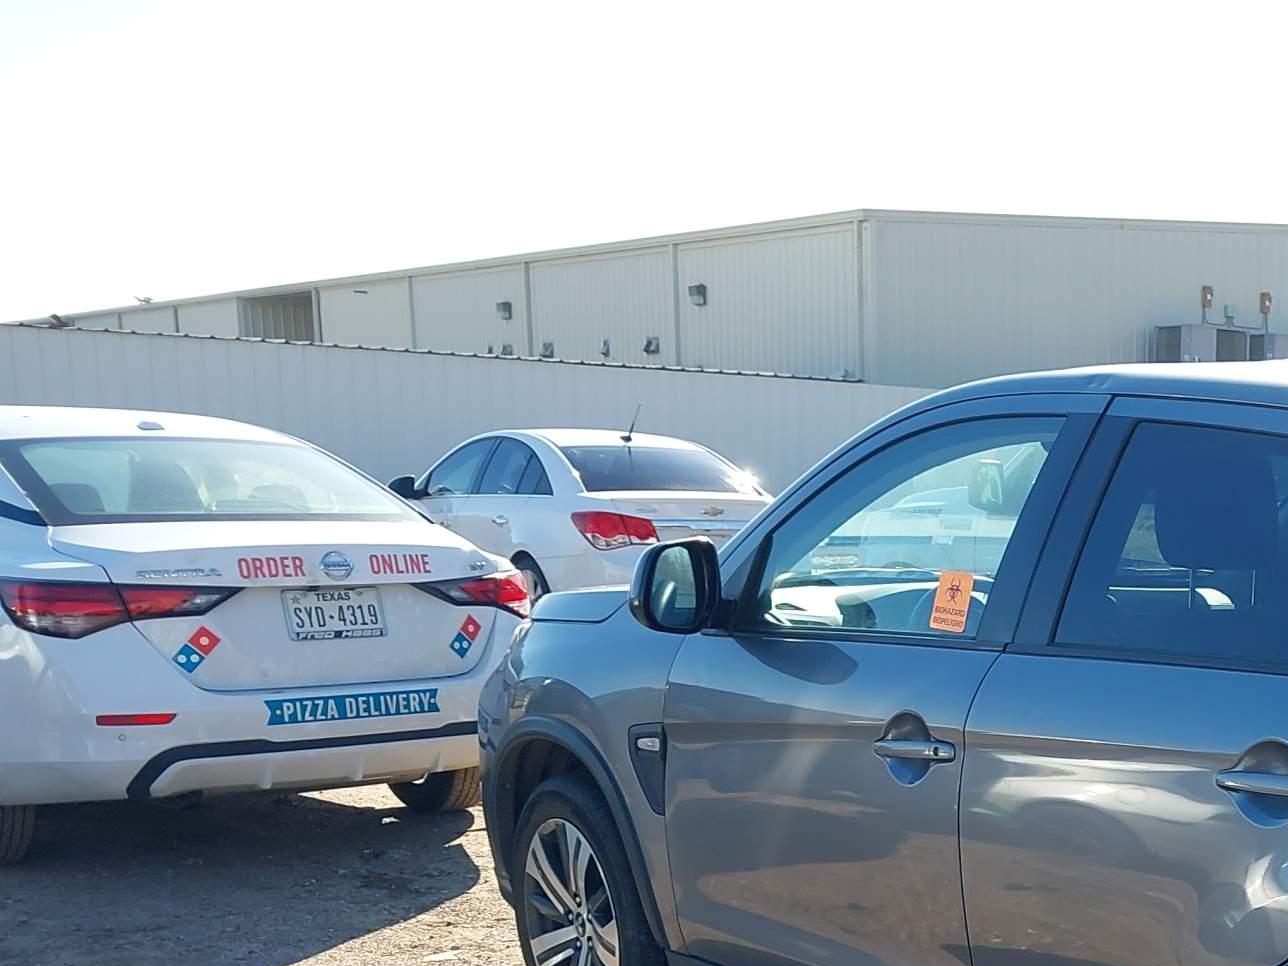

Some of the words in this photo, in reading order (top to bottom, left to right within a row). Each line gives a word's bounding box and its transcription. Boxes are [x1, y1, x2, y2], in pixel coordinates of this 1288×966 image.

[135, 567, 222, 580] SENTRA
[238, 556, 306, 580] ORDER
[369, 553, 432, 575] ONLINE
[314, 591, 351, 602] TEXAS
[282, 699, 339, 723] PIZZA
[345, 692, 431, 719] DELIVERY
